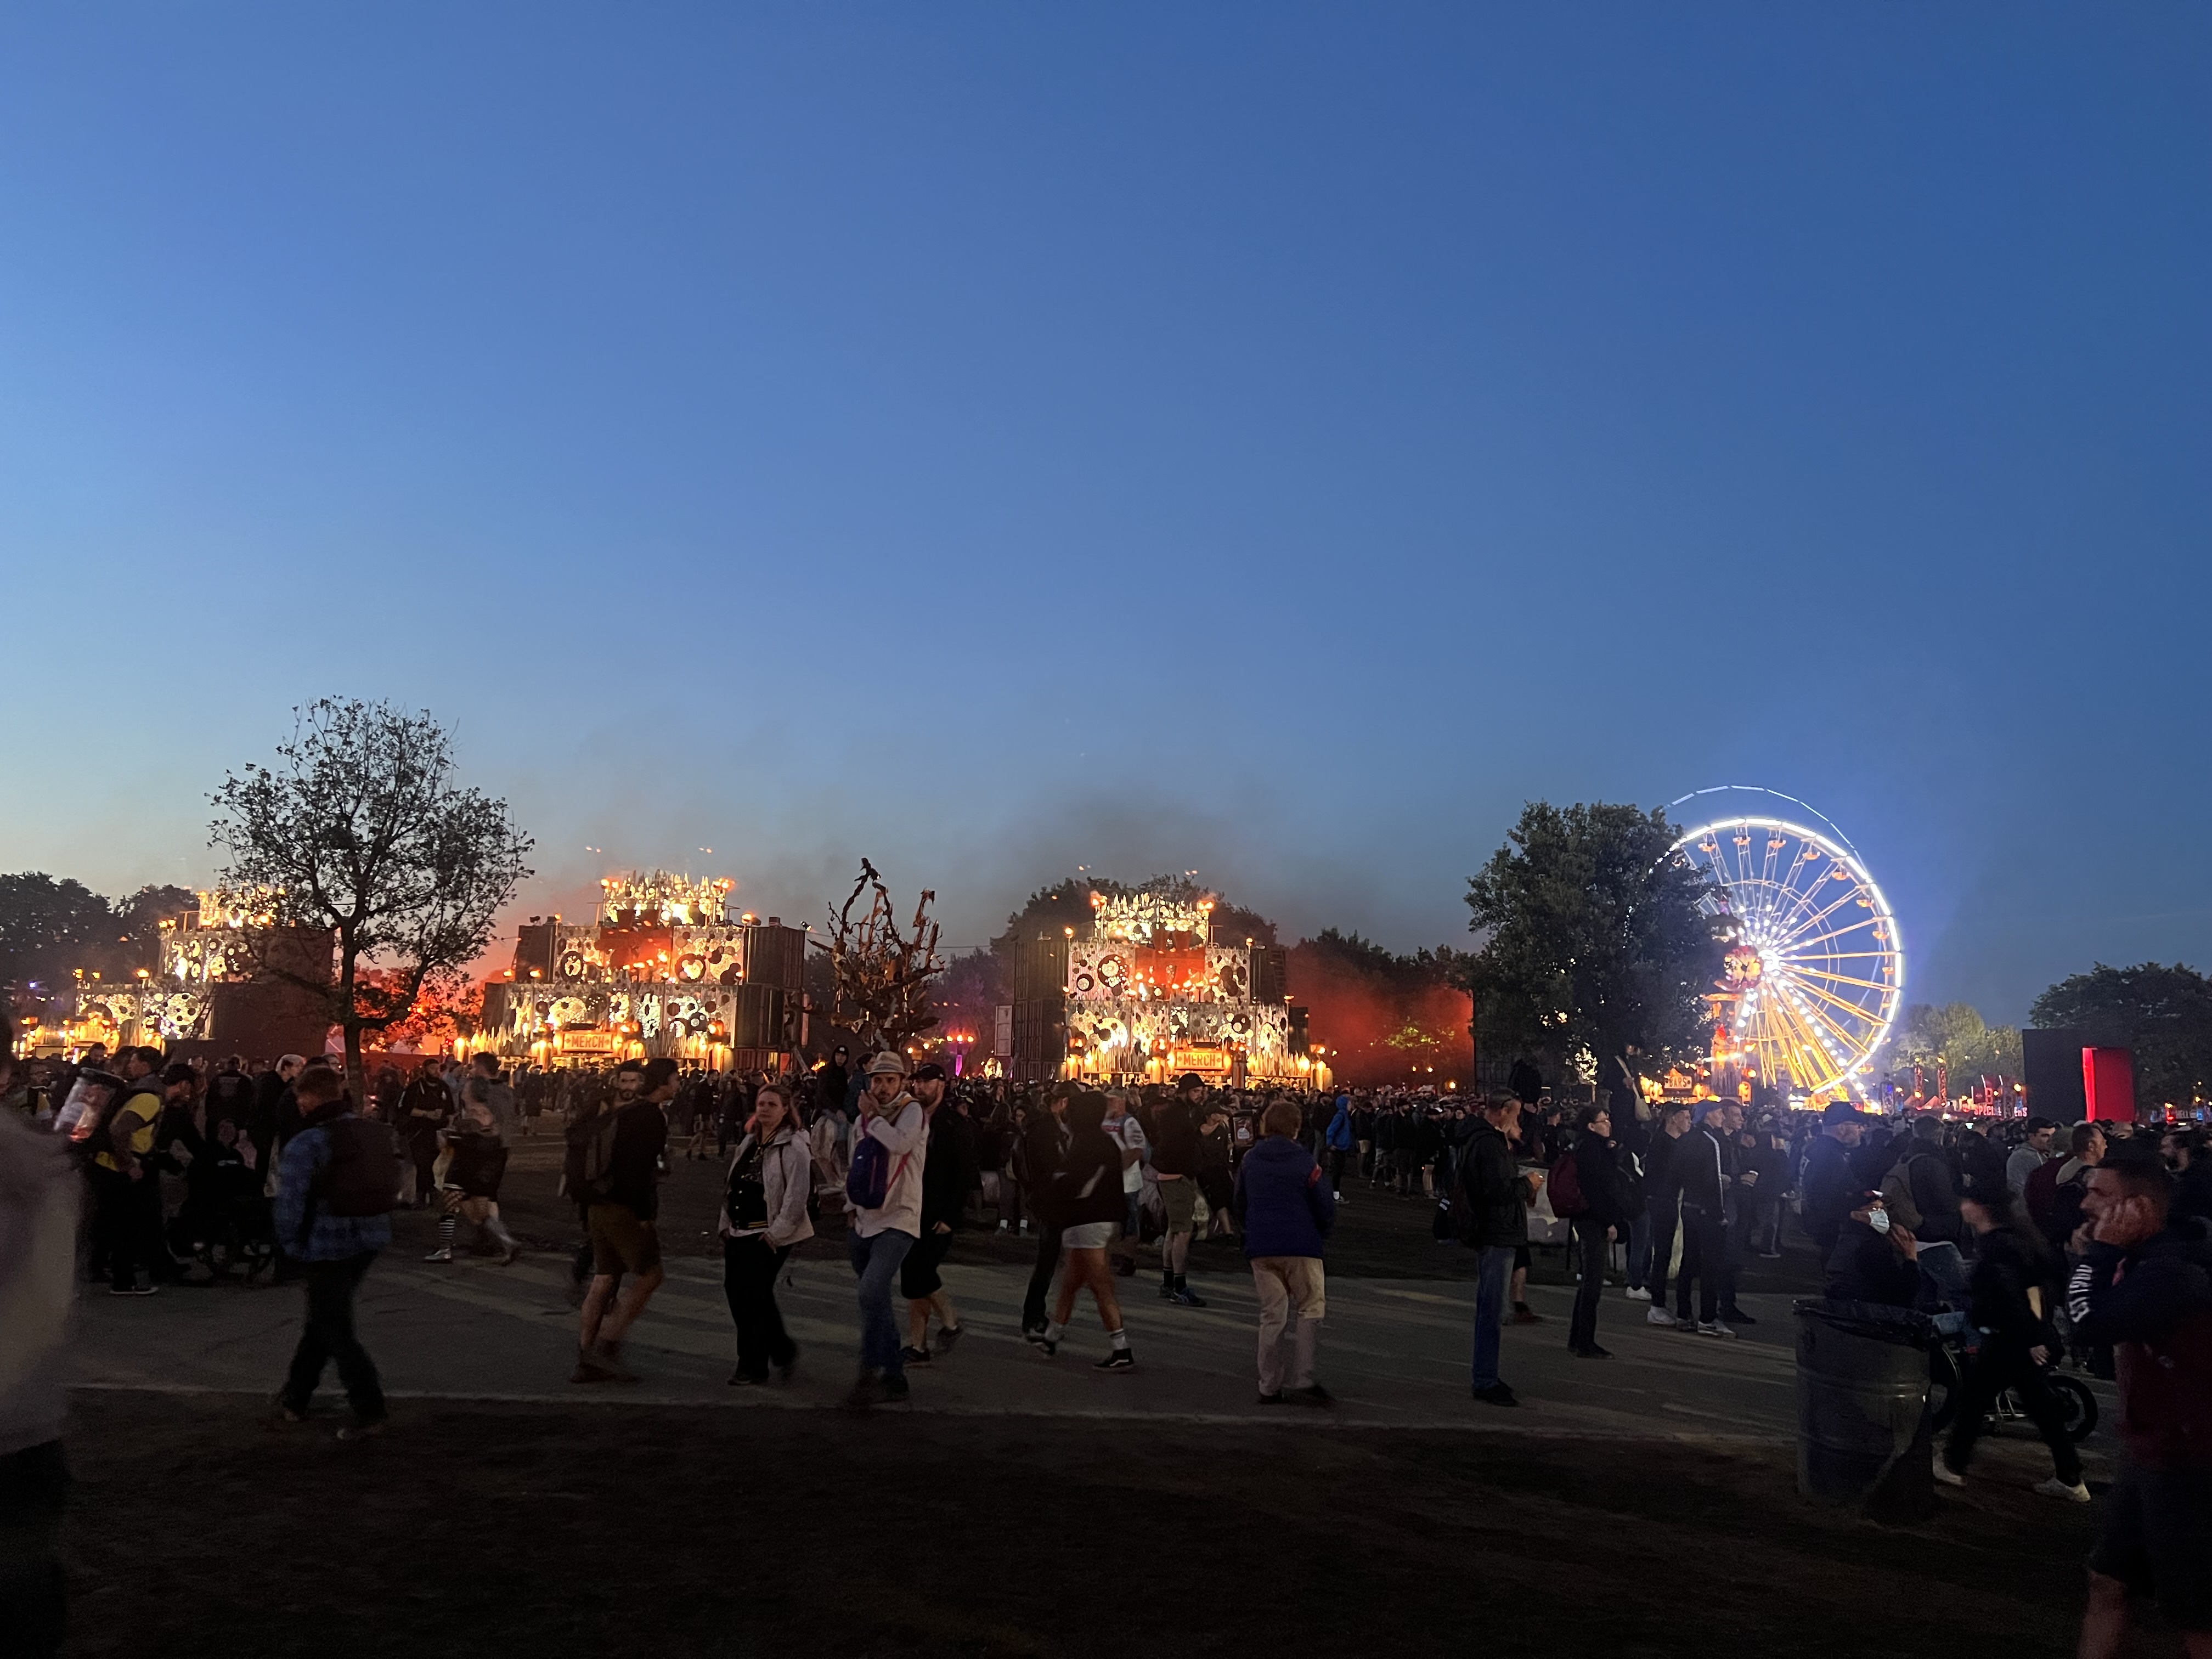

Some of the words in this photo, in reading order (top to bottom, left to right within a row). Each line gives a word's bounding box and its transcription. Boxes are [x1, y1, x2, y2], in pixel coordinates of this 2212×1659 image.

[571, 1035, 605, 1048] MERCH
[1183, 1053, 1215, 1066] MERCH
[1669, 1077, 1687, 1087] BARS
[1974, 1104, 2002, 1116] SPECIL
